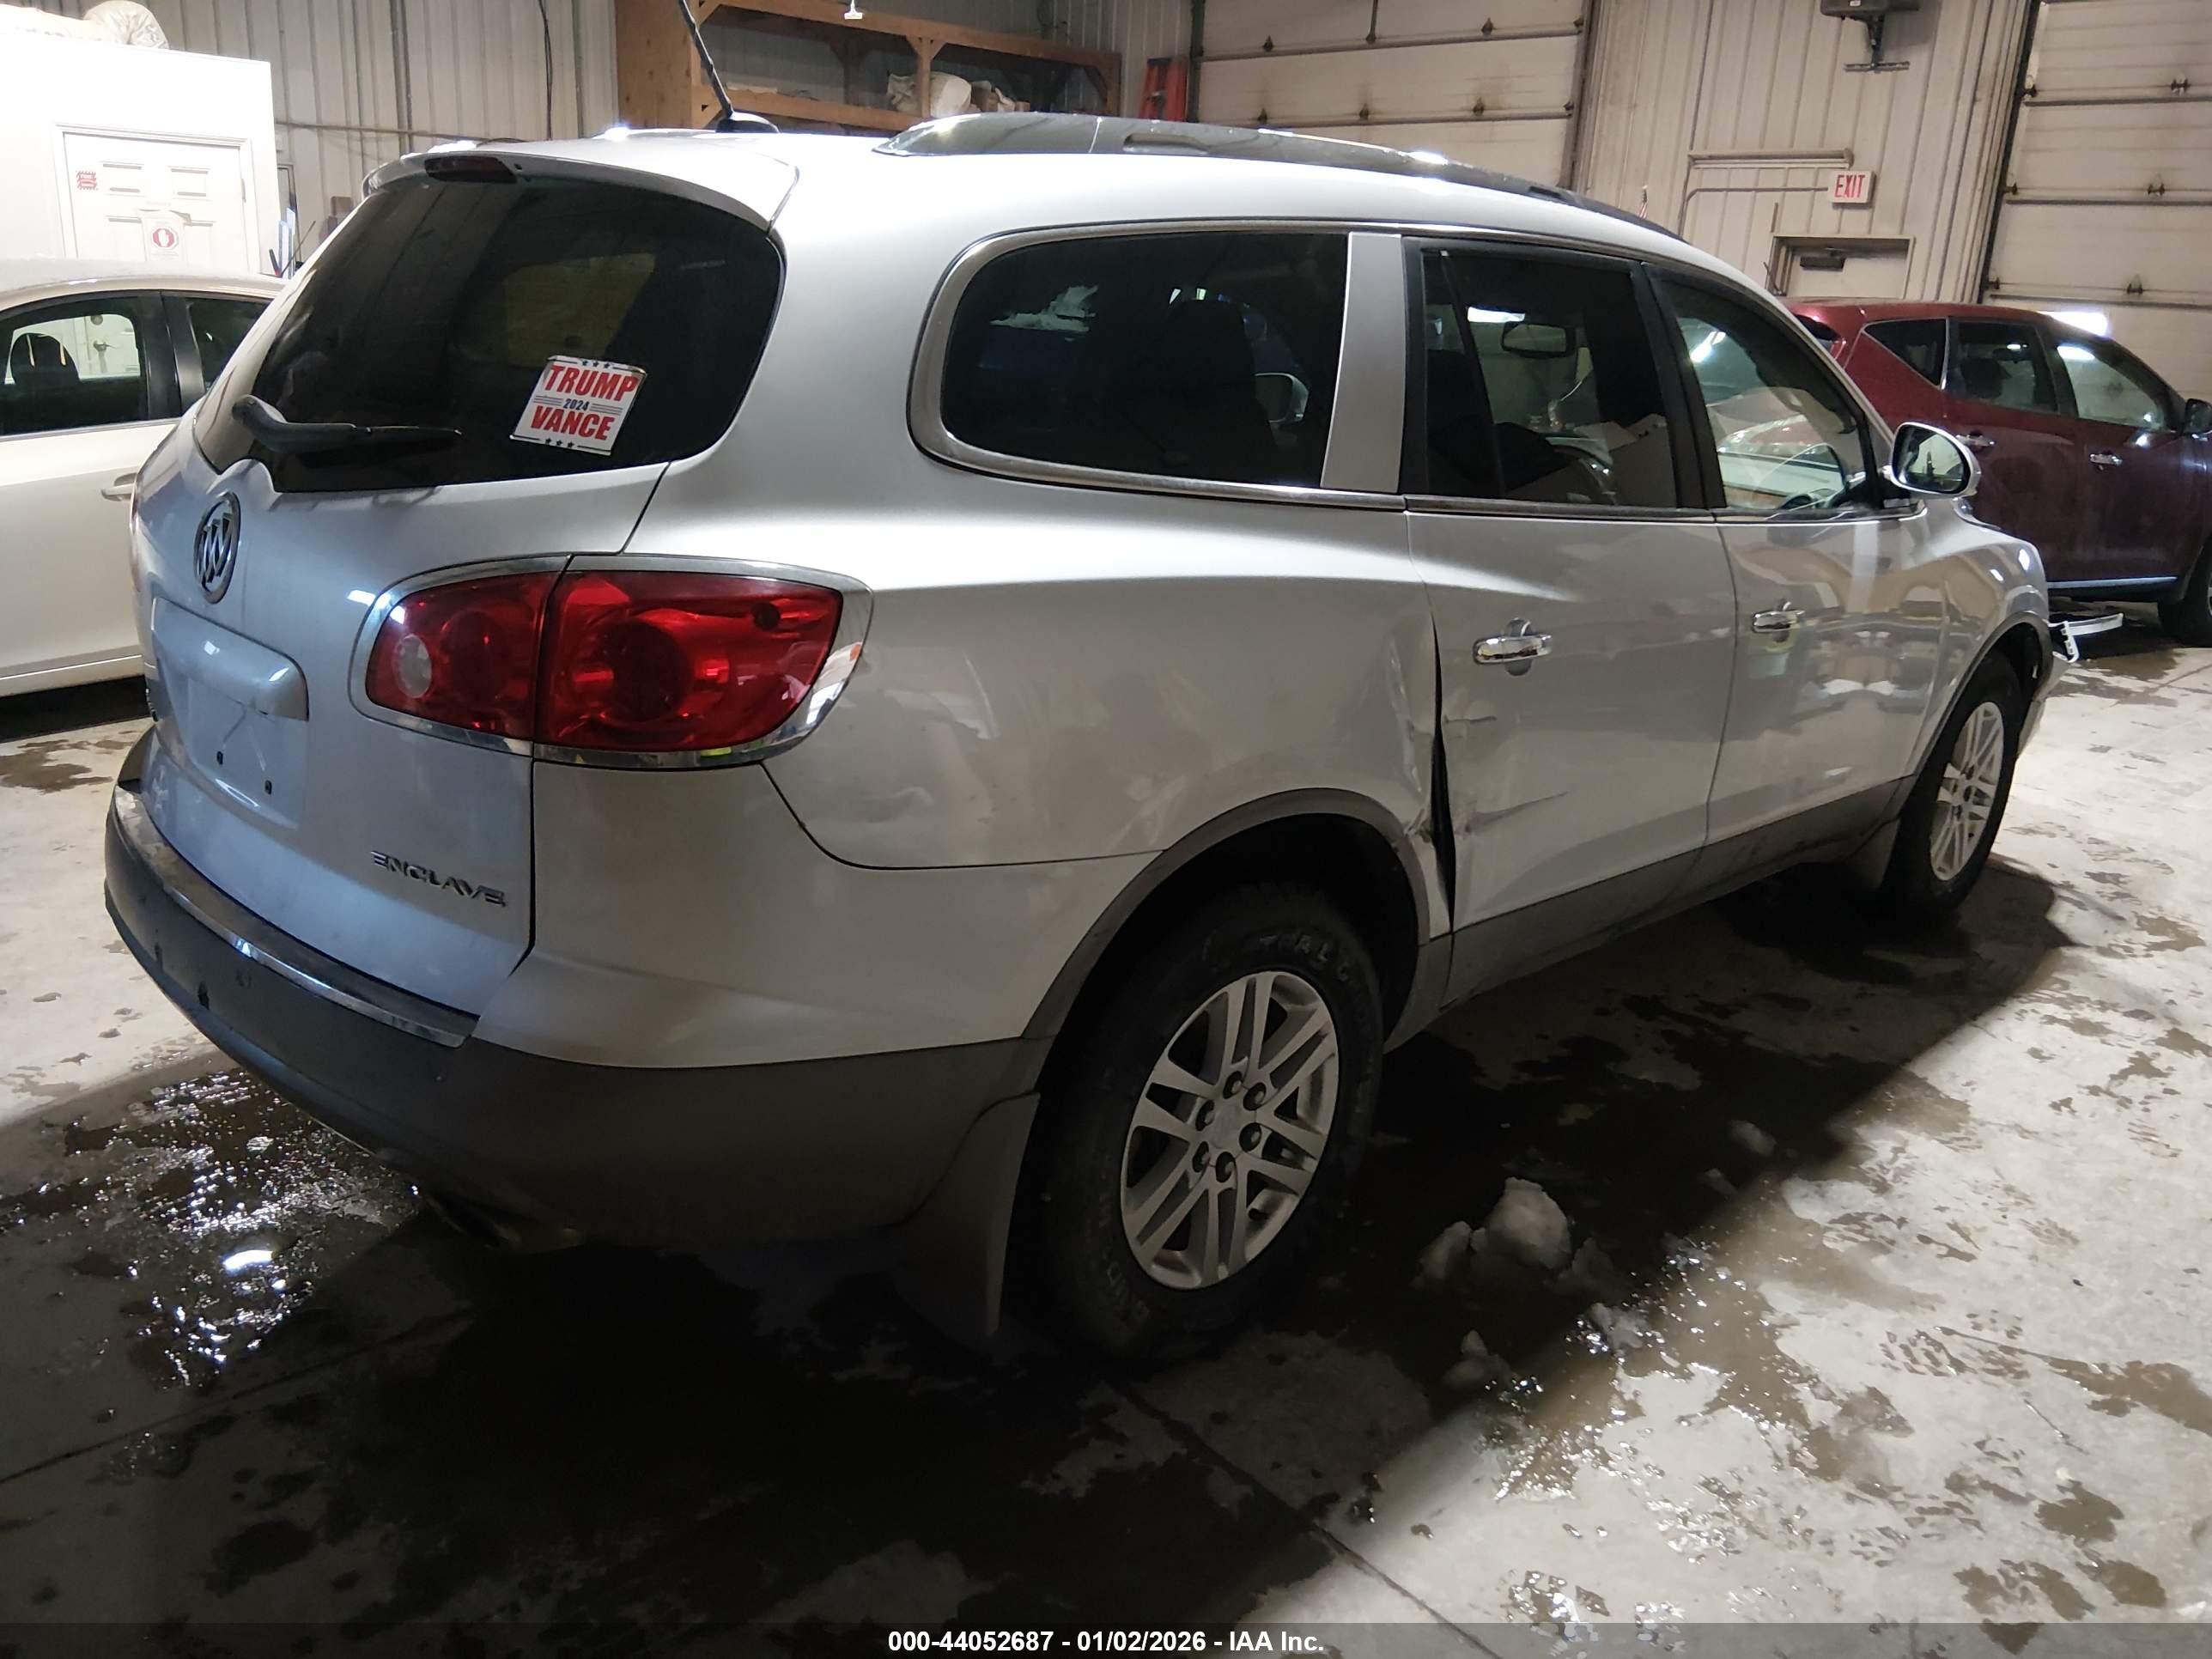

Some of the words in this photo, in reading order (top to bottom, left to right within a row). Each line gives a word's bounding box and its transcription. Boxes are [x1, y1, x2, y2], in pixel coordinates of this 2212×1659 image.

[1834, 174, 1866, 198] EXIT
[544, 364, 639, 401] TRUMP
[530, 404, 615, 441] VANCE
[562, 398, 591, 411] 2024
[370, 849, 507, 907] ENCLAVE
